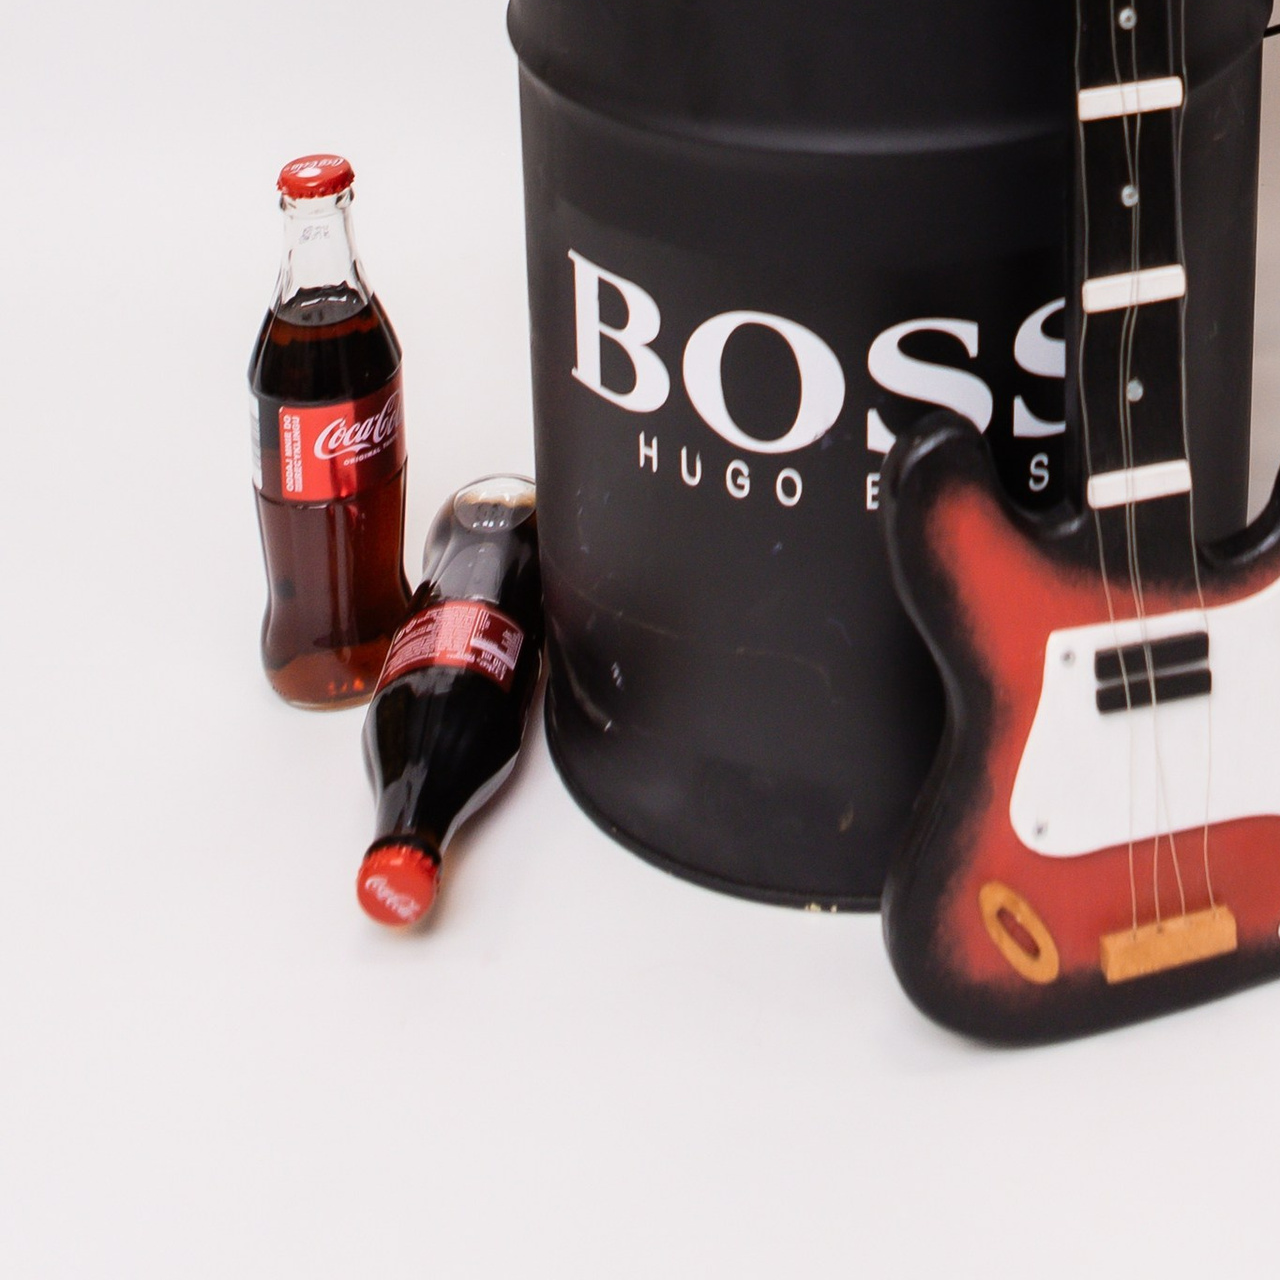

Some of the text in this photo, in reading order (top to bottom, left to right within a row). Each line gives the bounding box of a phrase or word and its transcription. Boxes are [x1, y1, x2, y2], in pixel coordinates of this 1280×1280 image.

[313, 389, 402, 461] Coca-Co
[638, 430, 1051, 511] HUGO BS
